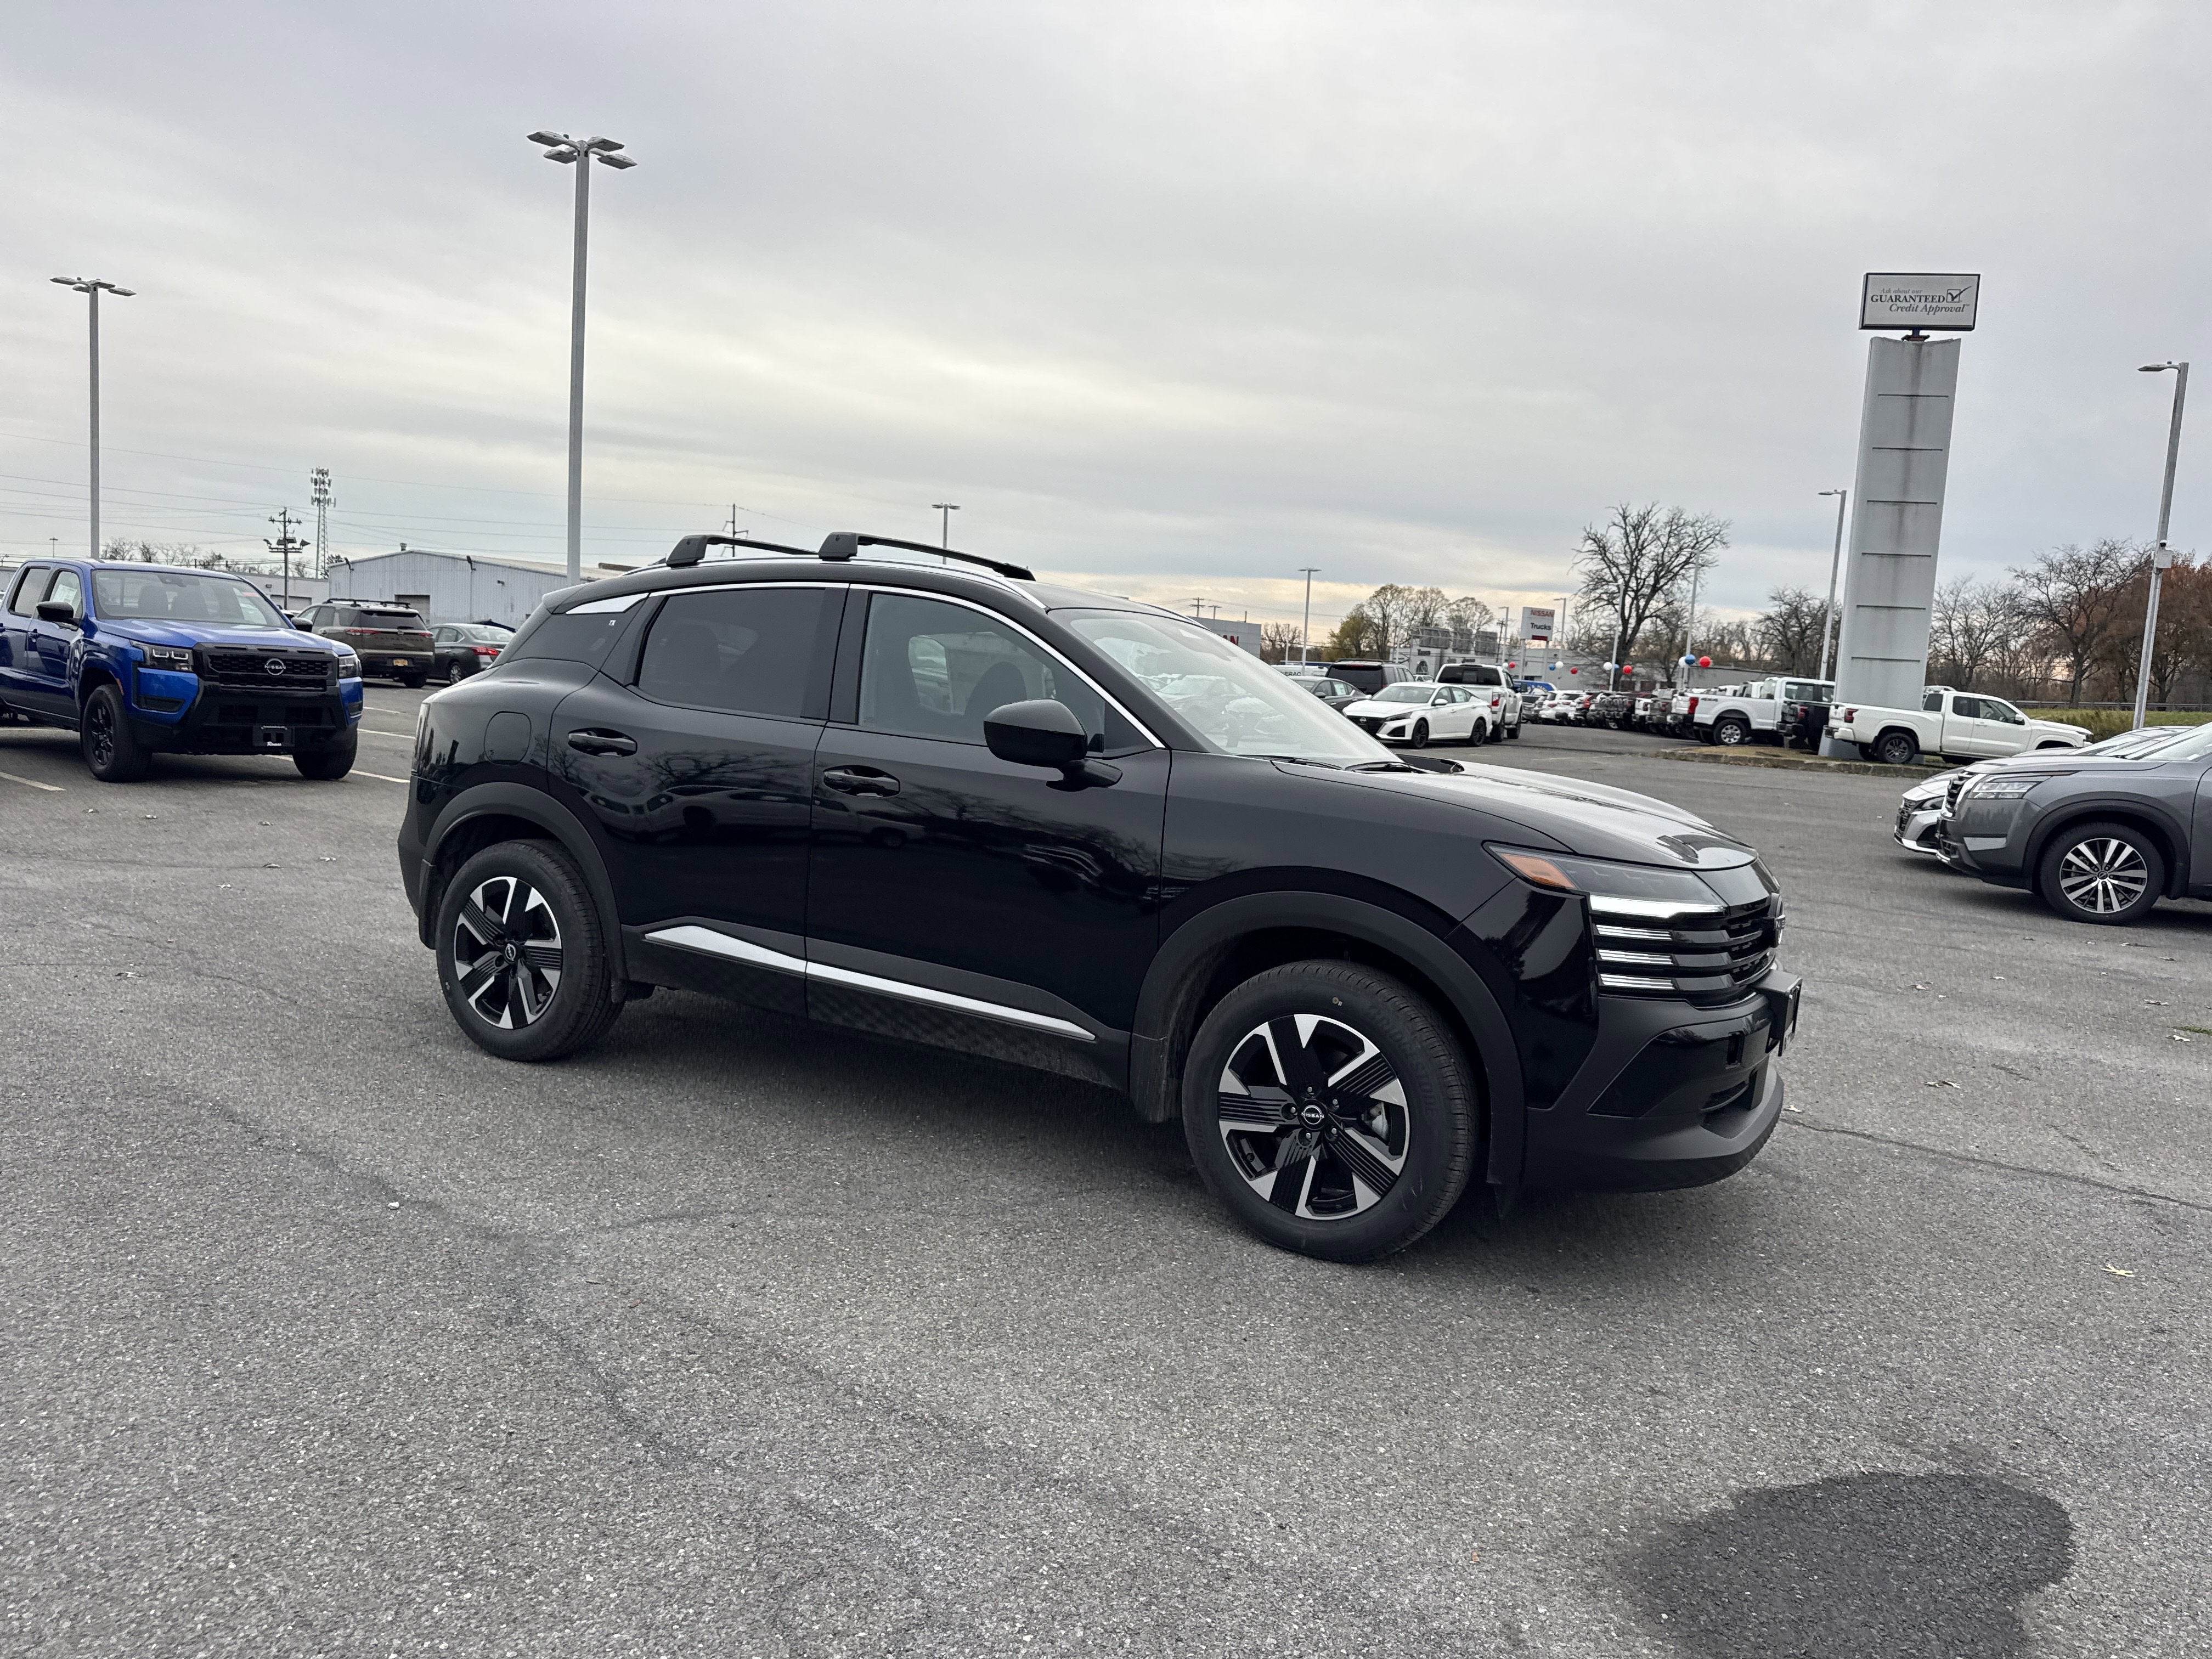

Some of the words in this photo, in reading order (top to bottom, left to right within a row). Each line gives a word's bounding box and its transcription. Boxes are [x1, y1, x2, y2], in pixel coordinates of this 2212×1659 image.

[1870, 294, 1945, 303] GUARANTEED
[1889, 303, 1919, 312] Credit
[1530, 622, 1551, 630] Trucks
